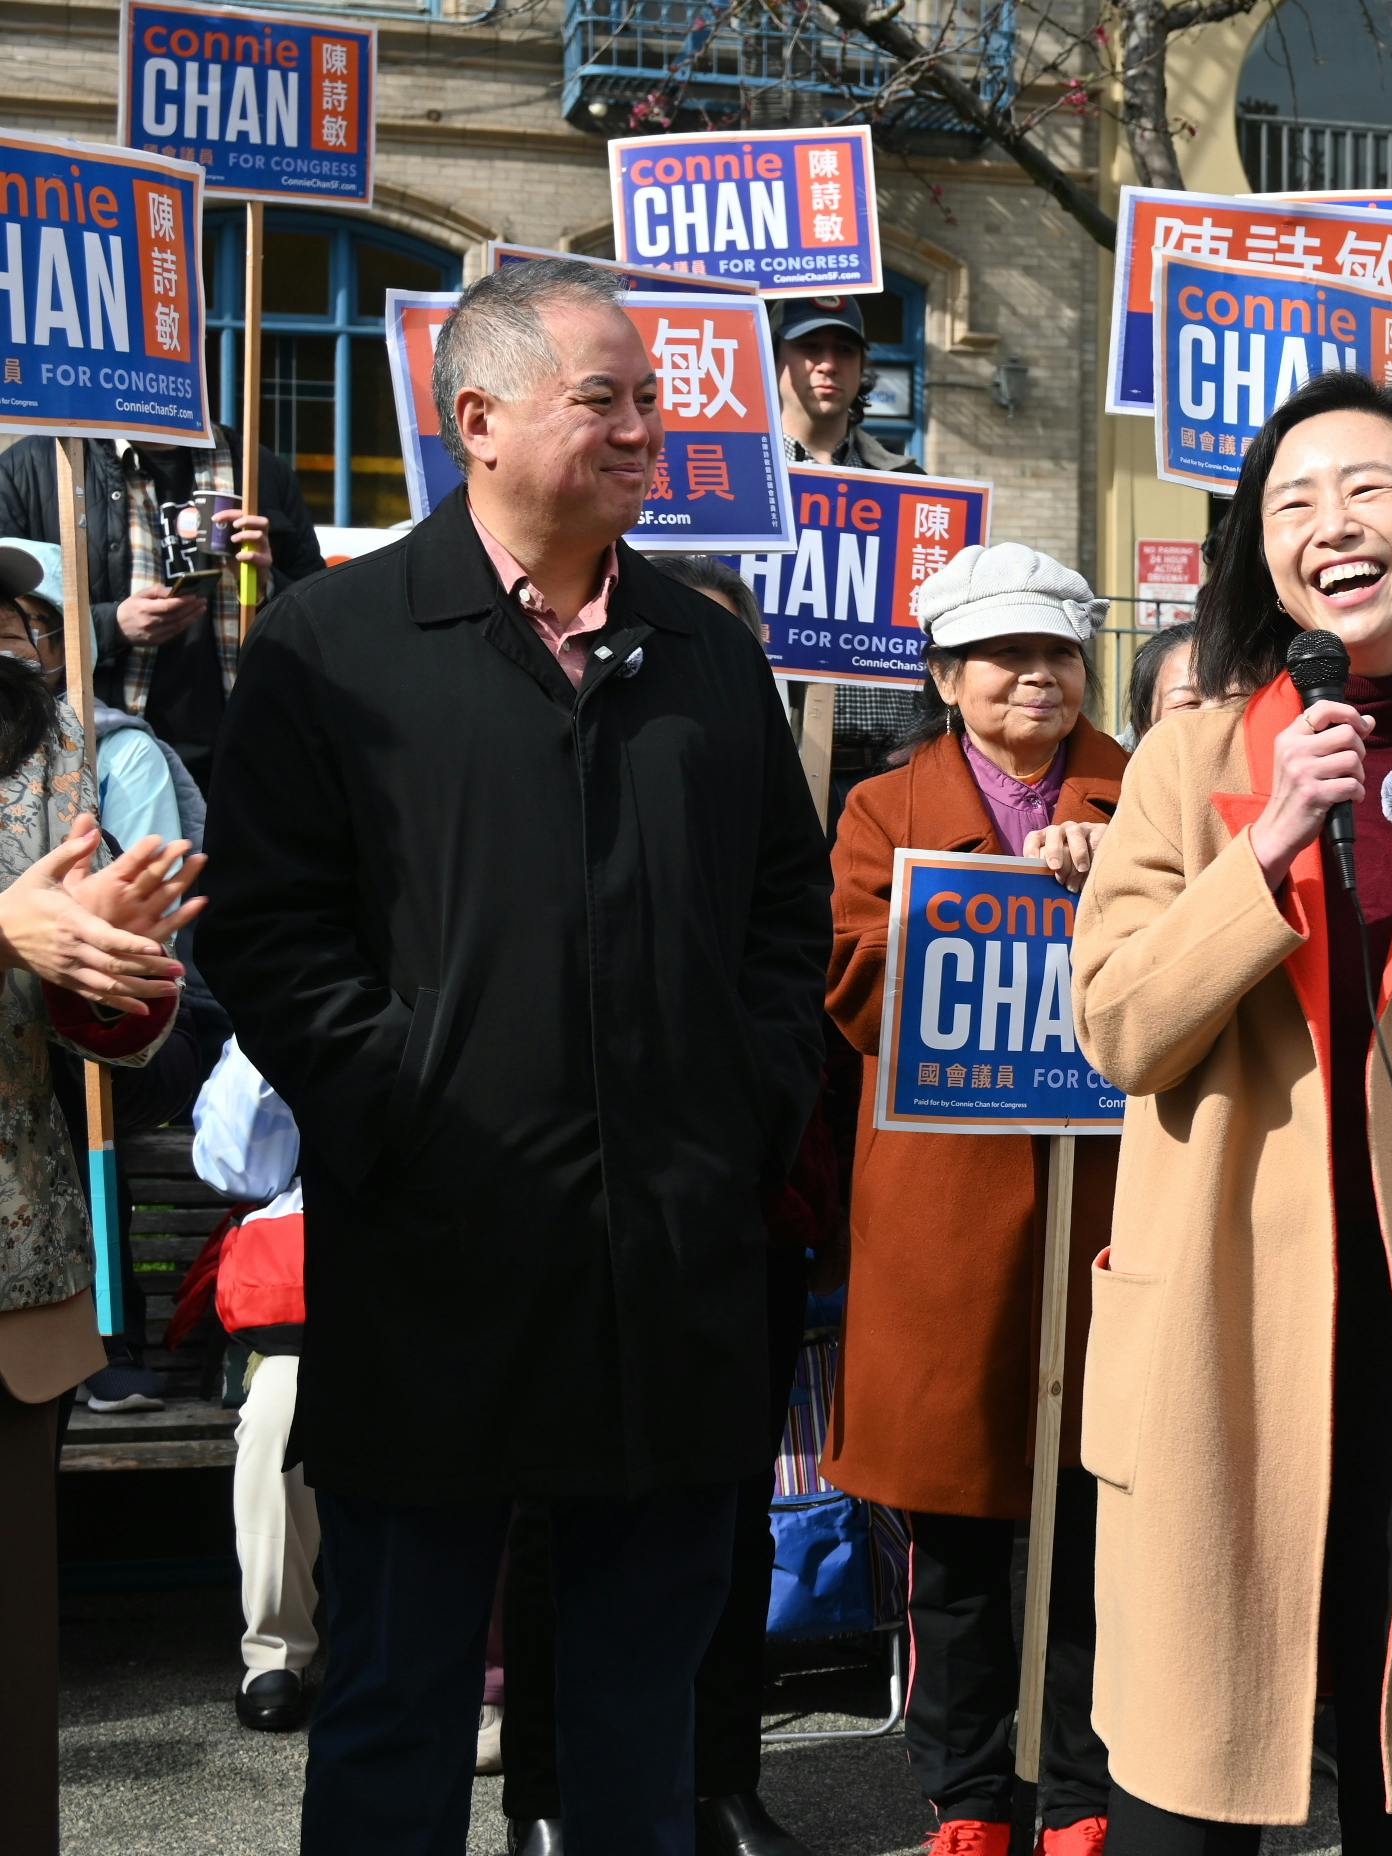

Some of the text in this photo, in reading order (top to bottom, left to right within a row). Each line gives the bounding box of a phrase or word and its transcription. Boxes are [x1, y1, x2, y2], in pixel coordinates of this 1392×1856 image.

[143, 25, 299, 68] connie
[142, 57, 299, 147] CHAN
[322, 43, 348, 147] 陳詩敏
[228, 153, 358, 177] FOR CONGRESS
[281, 176, 357, 191] ConnieChanSF.com
[630, 144, 783, 187] connie
[0, 165, 119, 229] nnie
[808, 149, 845, 243] 陳詩敏
[633, 180, 789, 258] CHAN
[148, 191, 181, 352] 陳詩敏
[719, 254, 860, 274] FOR CONGRESS
[773, 271, 861, 285] ConnieChanSF.com
[0, 222, 130, 353] HAN
[1178, 285, 1357, 342] connie
[40, 363, 92, 388] FOR
[100, 366, 192, 400] CONGRESS
[115, 397, 194, 421] ConnieChanSF.com
[800, 483, 882, 532] nie
[740, 528, 880, 624] HAN
[788, 628, 832, 648] FOR
[839, 633, 926, 656] CONGR
[852, 656, 928, 672] ConnieChanS
[925, 890, 1077, 937] conn
[919, 937, 1075, 1053] CHA
[917, 1062, 1015, 1089] 國會議員
[1033, 1068, 1079, 1089] FOR
[913, 1098, 929, 1107] Paid
[929, 1098, 940, 1107] for
[940, 1099, 950, 1108] by
[950, 1100, 974, 1108] Connie
[974, 1100, 990, 1108] Chan
[1000, 1101, 1028, 1110] Congress
